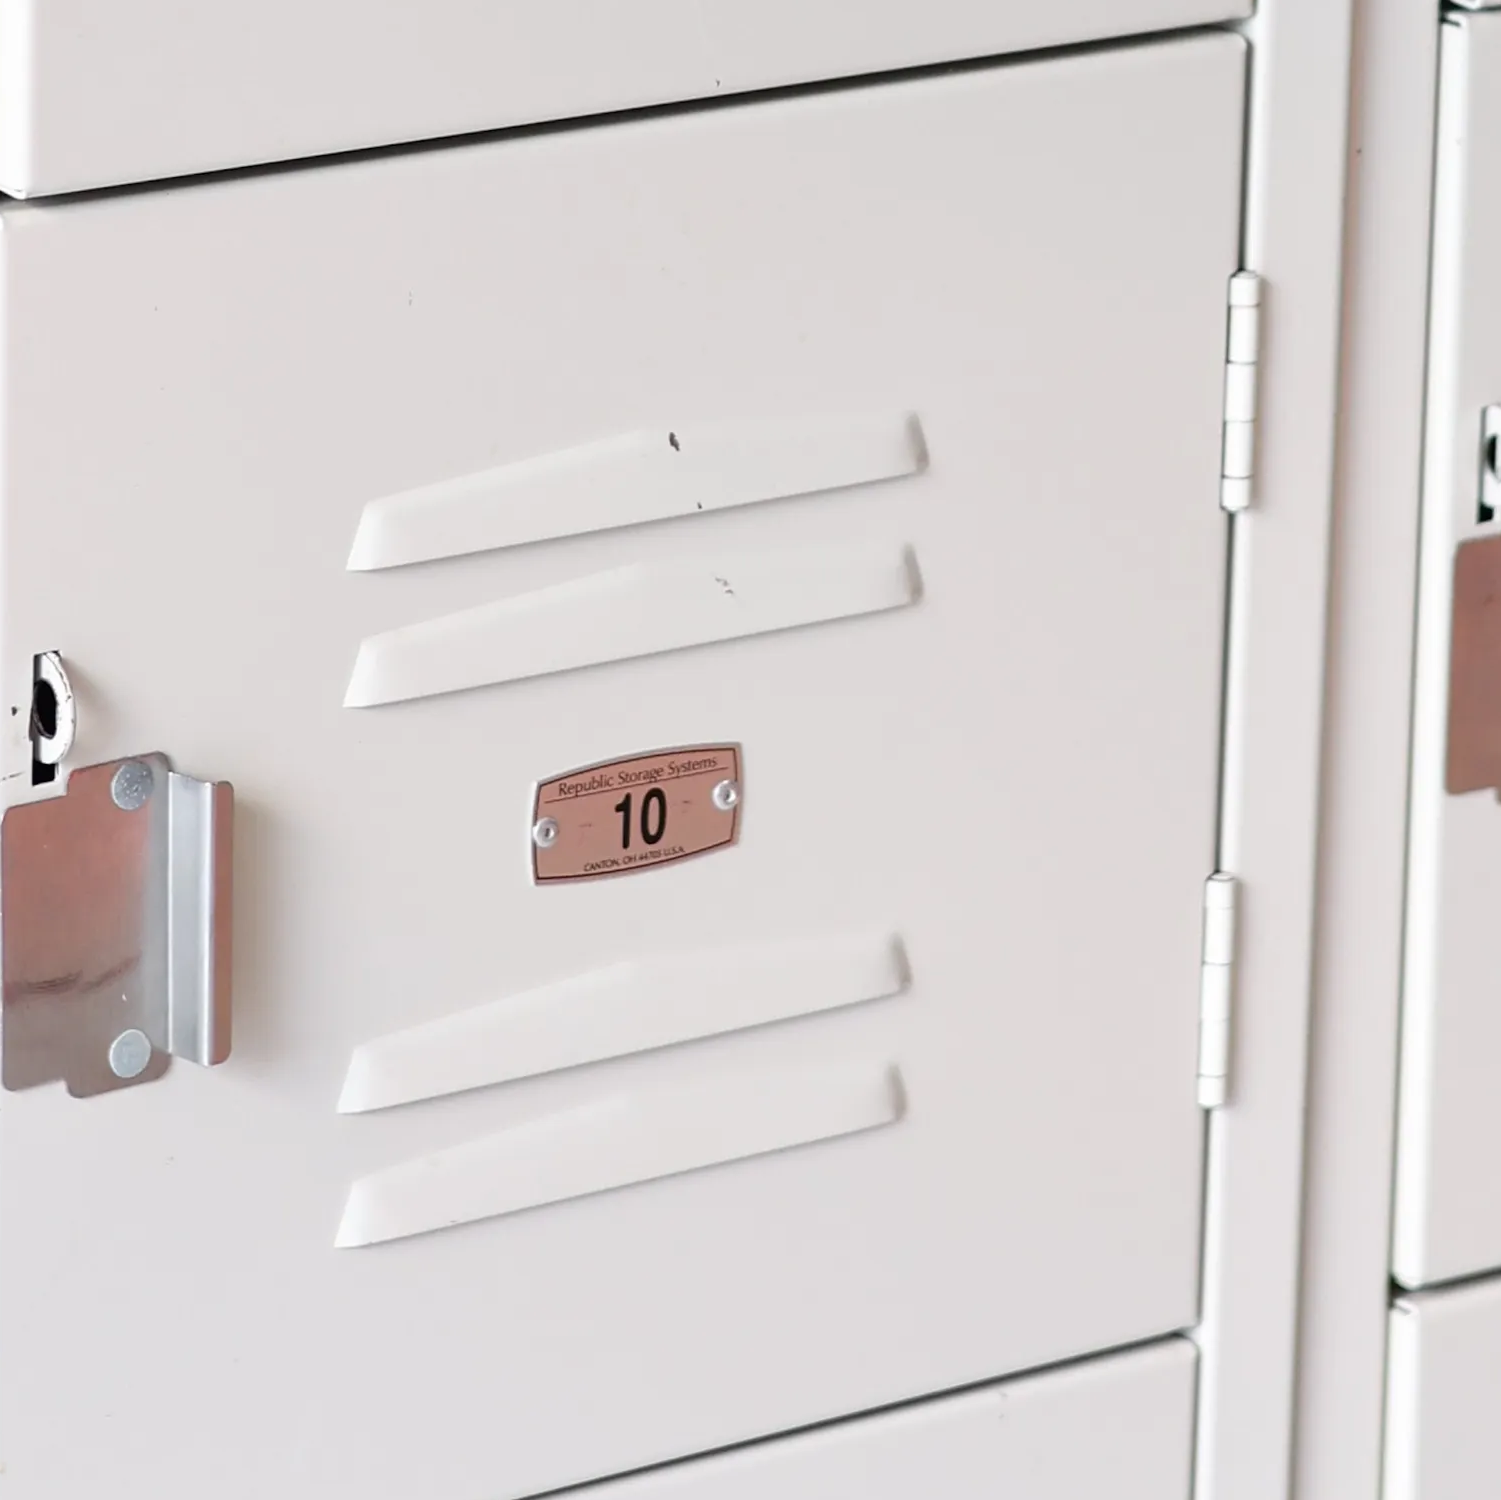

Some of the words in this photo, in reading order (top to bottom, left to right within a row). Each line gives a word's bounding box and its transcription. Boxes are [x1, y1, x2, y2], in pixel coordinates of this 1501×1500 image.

[558, 774, 614, 797] Republic
[618, 766, 664, 784] Storage
[668, 756, 717, 777] Systems
[614, 787, 667, 850] 10
[622, 854, 637, 865] OH
